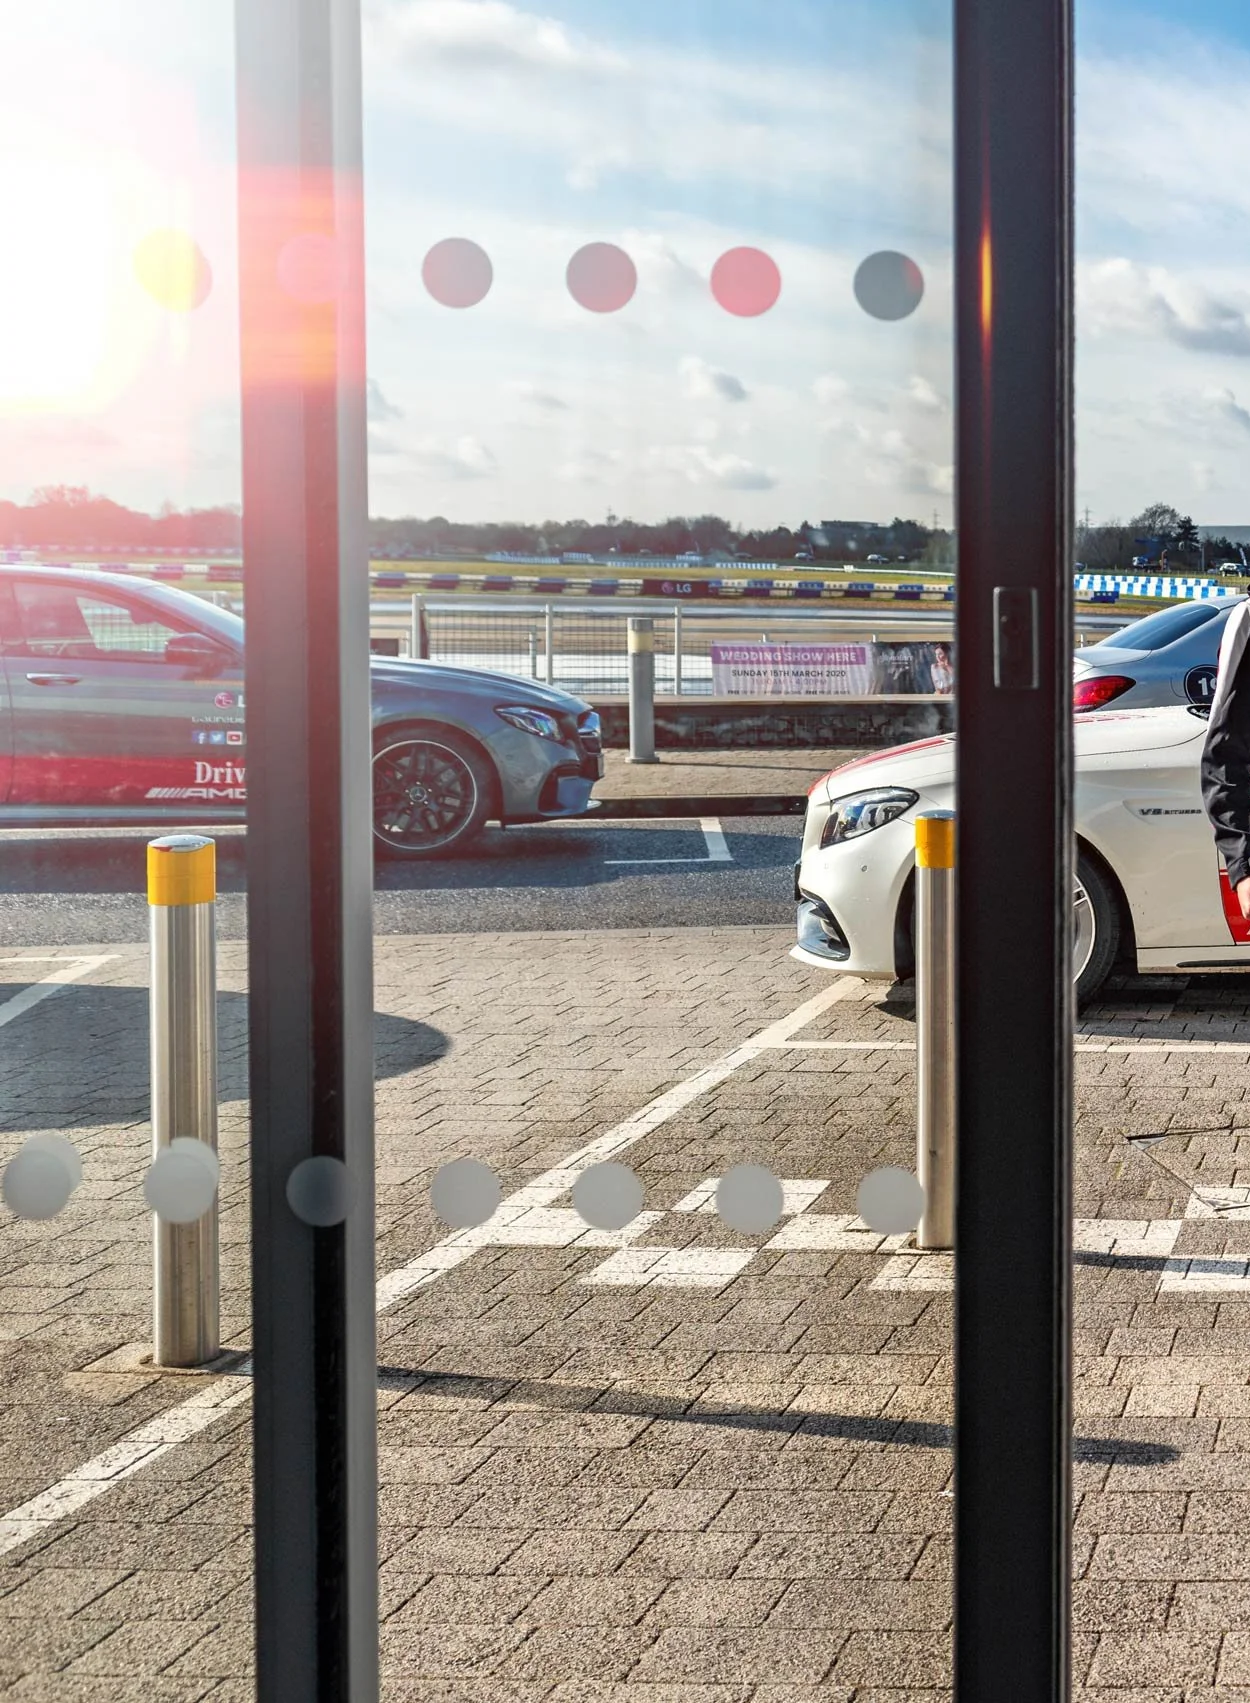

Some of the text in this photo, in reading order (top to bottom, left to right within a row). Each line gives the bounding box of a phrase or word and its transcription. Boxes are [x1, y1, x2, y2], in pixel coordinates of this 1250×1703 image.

[676, 583, 692, 593] LG
[720, 651, 857, 661] WEDDING SHOW HERE
[238, 694, 246, 708] L
[194, 761, 246, 784] Driv
